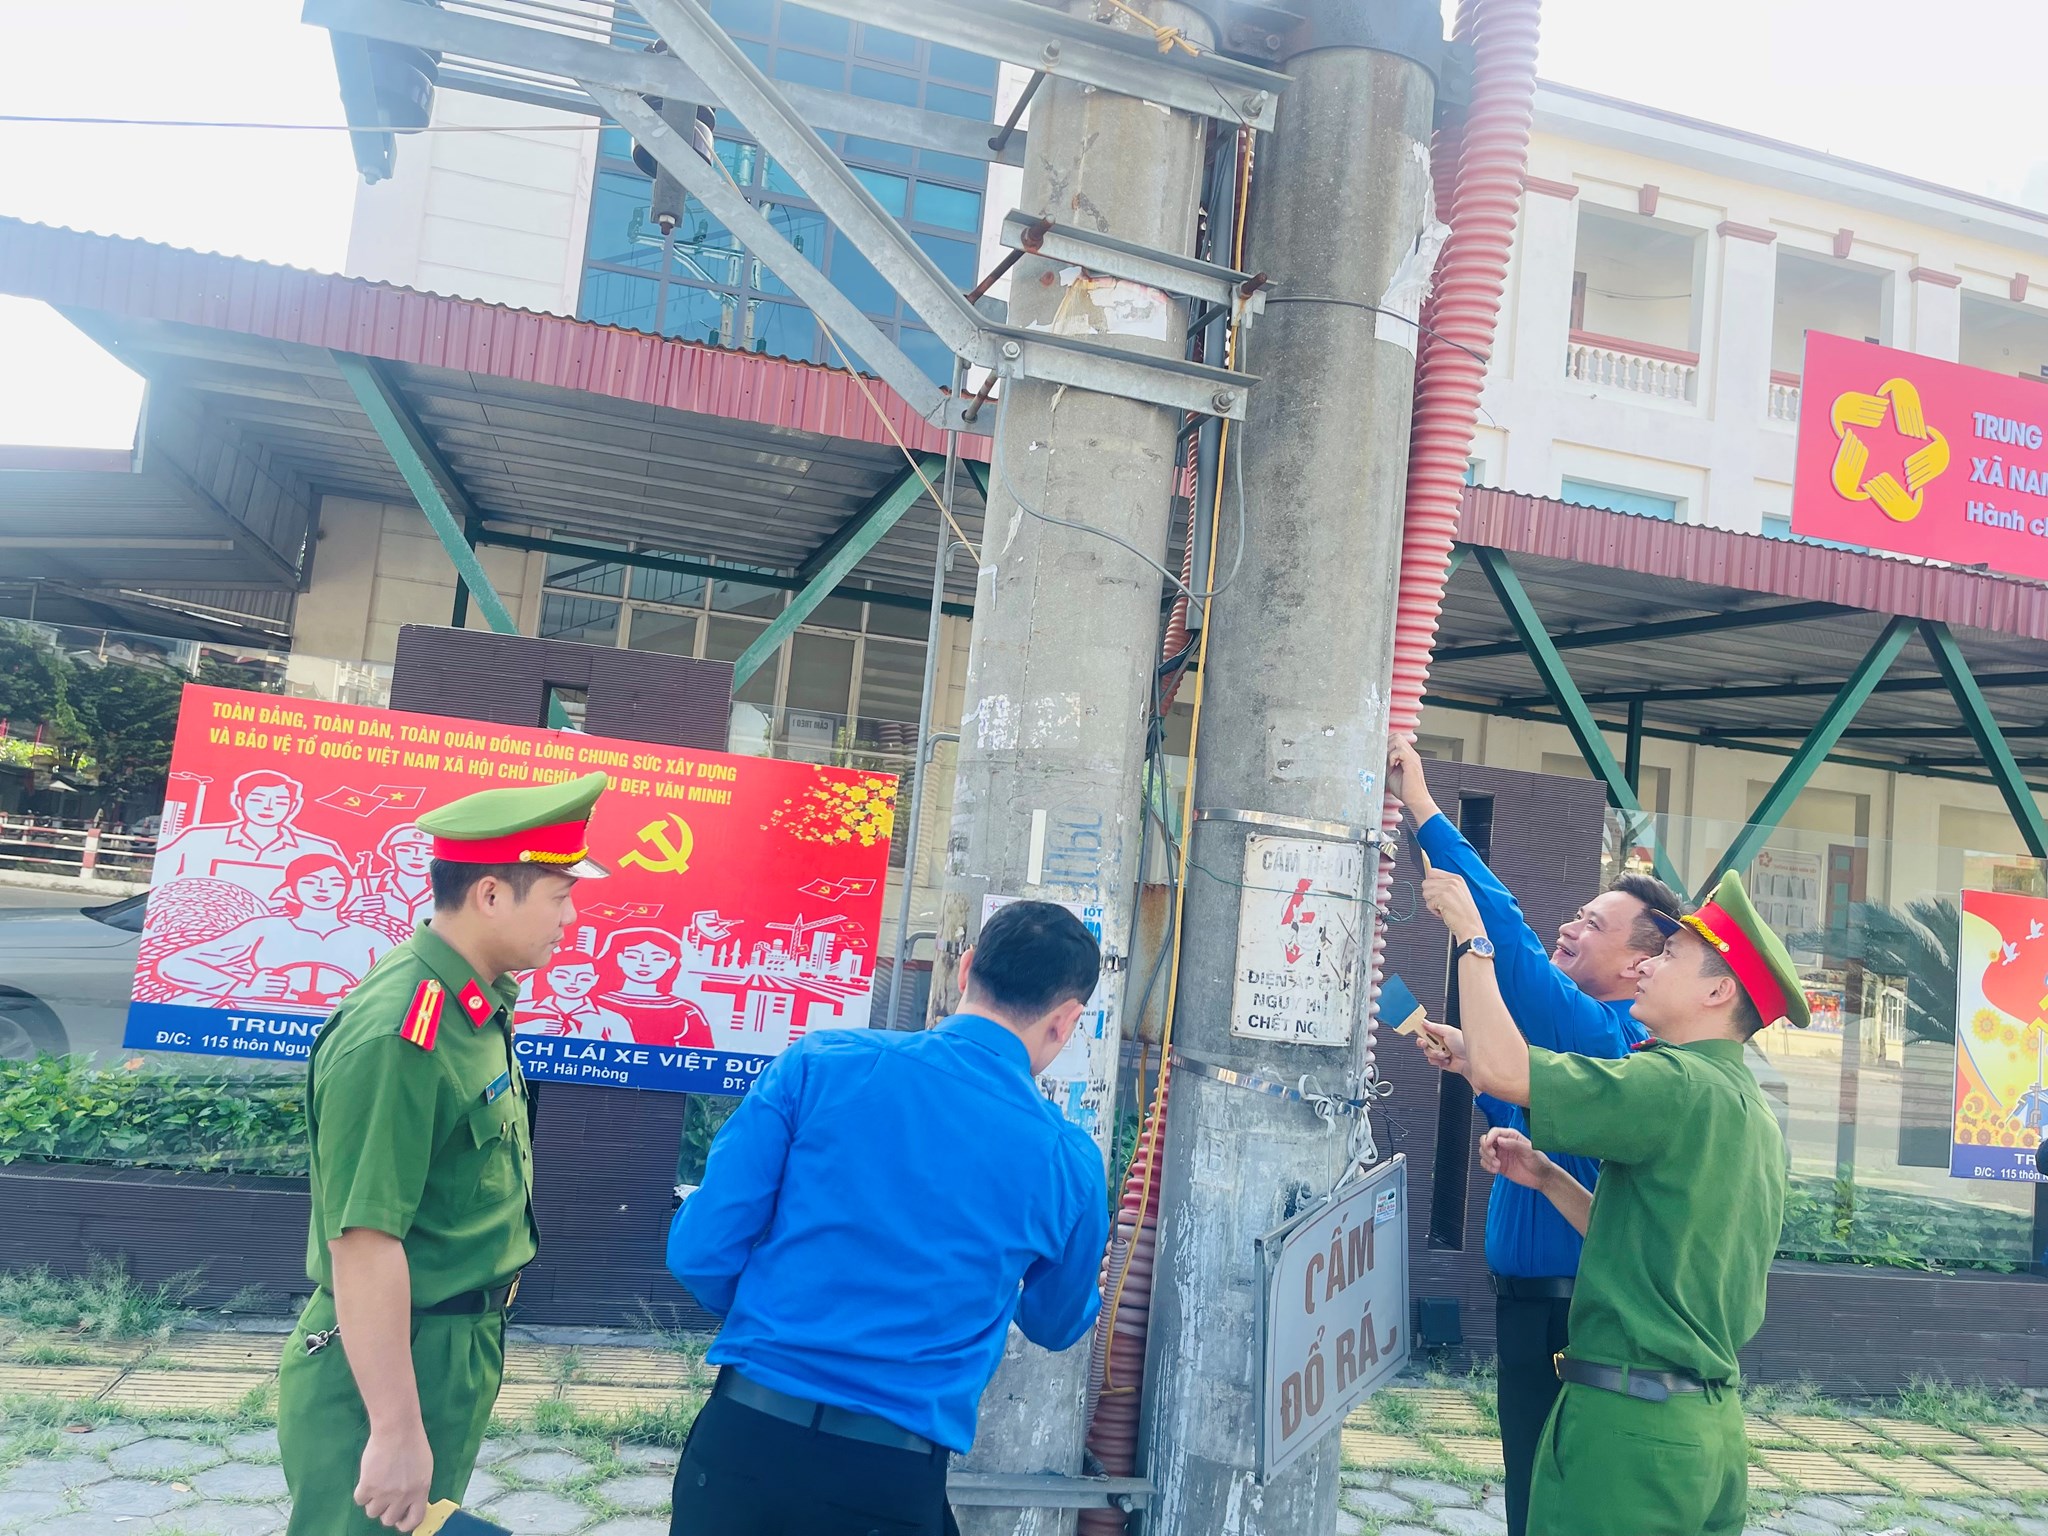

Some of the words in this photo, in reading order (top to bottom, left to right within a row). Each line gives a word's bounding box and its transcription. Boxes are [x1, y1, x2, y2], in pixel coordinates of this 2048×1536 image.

[1972, 411, 2043, 450] TRUNG
[1969, 455, 2005, 487] XÃ
[1966, 500, 2025, 532] Hành
[212, 702, 255, 722] TOÀN
[259, 705, 308, 730] ĐẢNG,
[313, 714, 354, 734] TOÀN
[358, 719, 395, 741] DÂN,
[400, 725, 440, 745] TOÀN
[444, 731, 487, 751] QUÂN
[489, 734, 532, 757] ĐỒNG
[534, 740, 574, 761] LÒNG
[578, 748, 629, 768] CHUNG
[632, 753, 662, 773] SỨC
[665, 758, 695, 777] XÂY
[697, 763, 737, 782] DỰNG
[210, 726, 230, 745] VÀ
[234, 728, 268, 749] BẢO
[273, 734, 293, 755] VỆ
[297, 735, 318, 755] TỔ
[320, 740, 362, 761] QUỐC
[367, 746, 400, 767] VIỆT
[403, 751, 440, 770] NAM
[443, 755, 464, 773] XÃ
[467, 758, 494, 779] HỘI
[498, 761, 529, 781] CHỦ
[621, 777, 650, 798] ĐẸP,
[655, 781, 684, 800] VĂN
[688, 787, 732, 805] MINH!
[1248, 1012, 1290, 1032] CHẾT
[156, 1031, 192, 1046] Đ/C:
[202, 1034, 229, 1049] 115
[232, 1038, 269, 1052] thôn
[563, 1043, 605, 1061] LÁI
[613, 1049, 650, 1066] XE
[658, 1052, 718, 1072] VIỆT
[528, 1060, 549, 1073] TP.
[553, 1063, 577, 1076] Hải
[581, 1065, 629, 1082] Phòng
[1974, 1166, 1995, 1178] Đ/C:
[2001, 1168, 2017, 1179] 115
[2019, 1169, 2040, 1180] thôn
[1304, 1212, 1375, 1315] CẤM
[1280, 1325, 1326, 1441] ĐỔ
